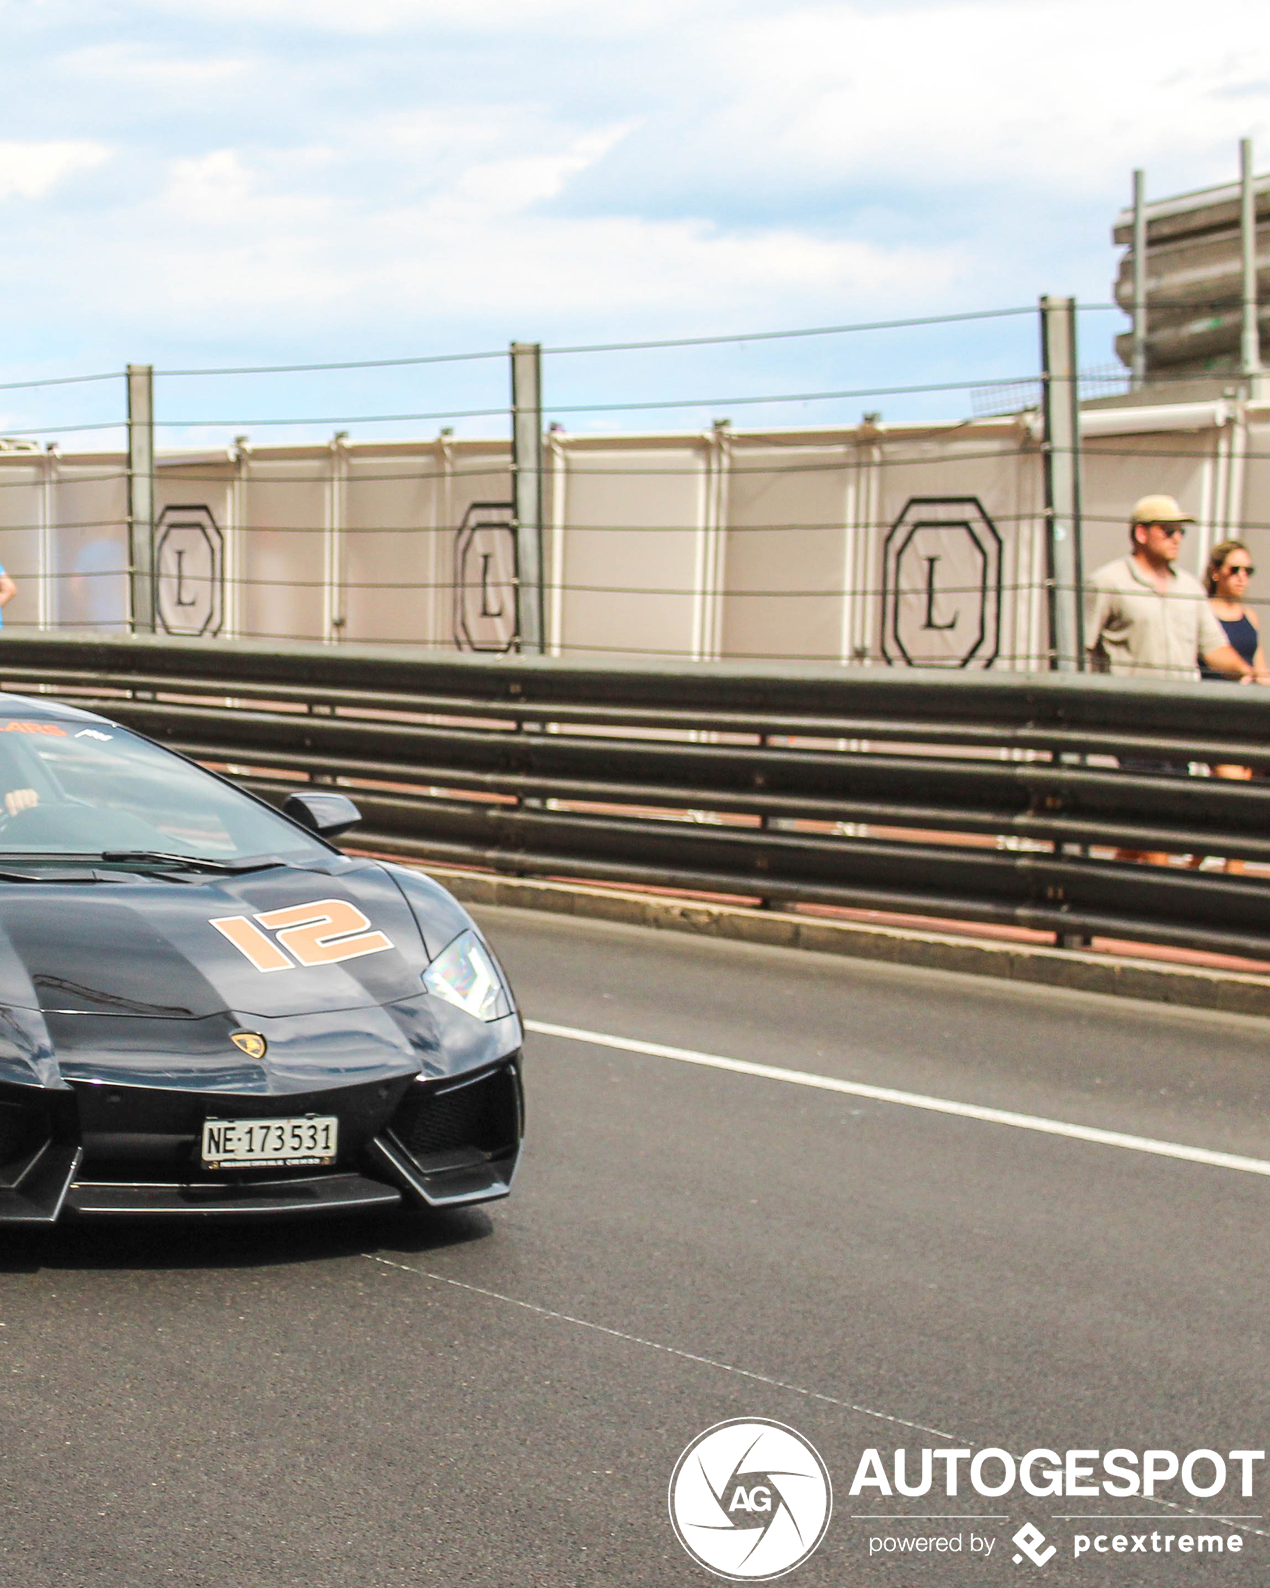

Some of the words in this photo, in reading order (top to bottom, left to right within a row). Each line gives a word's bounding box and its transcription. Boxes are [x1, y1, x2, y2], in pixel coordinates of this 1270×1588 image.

[176, 550, 196, 606] L
[480, 553, 504, 617] L
[922, 556, 959, 629] L
[208, 898, 395, 973] 12
